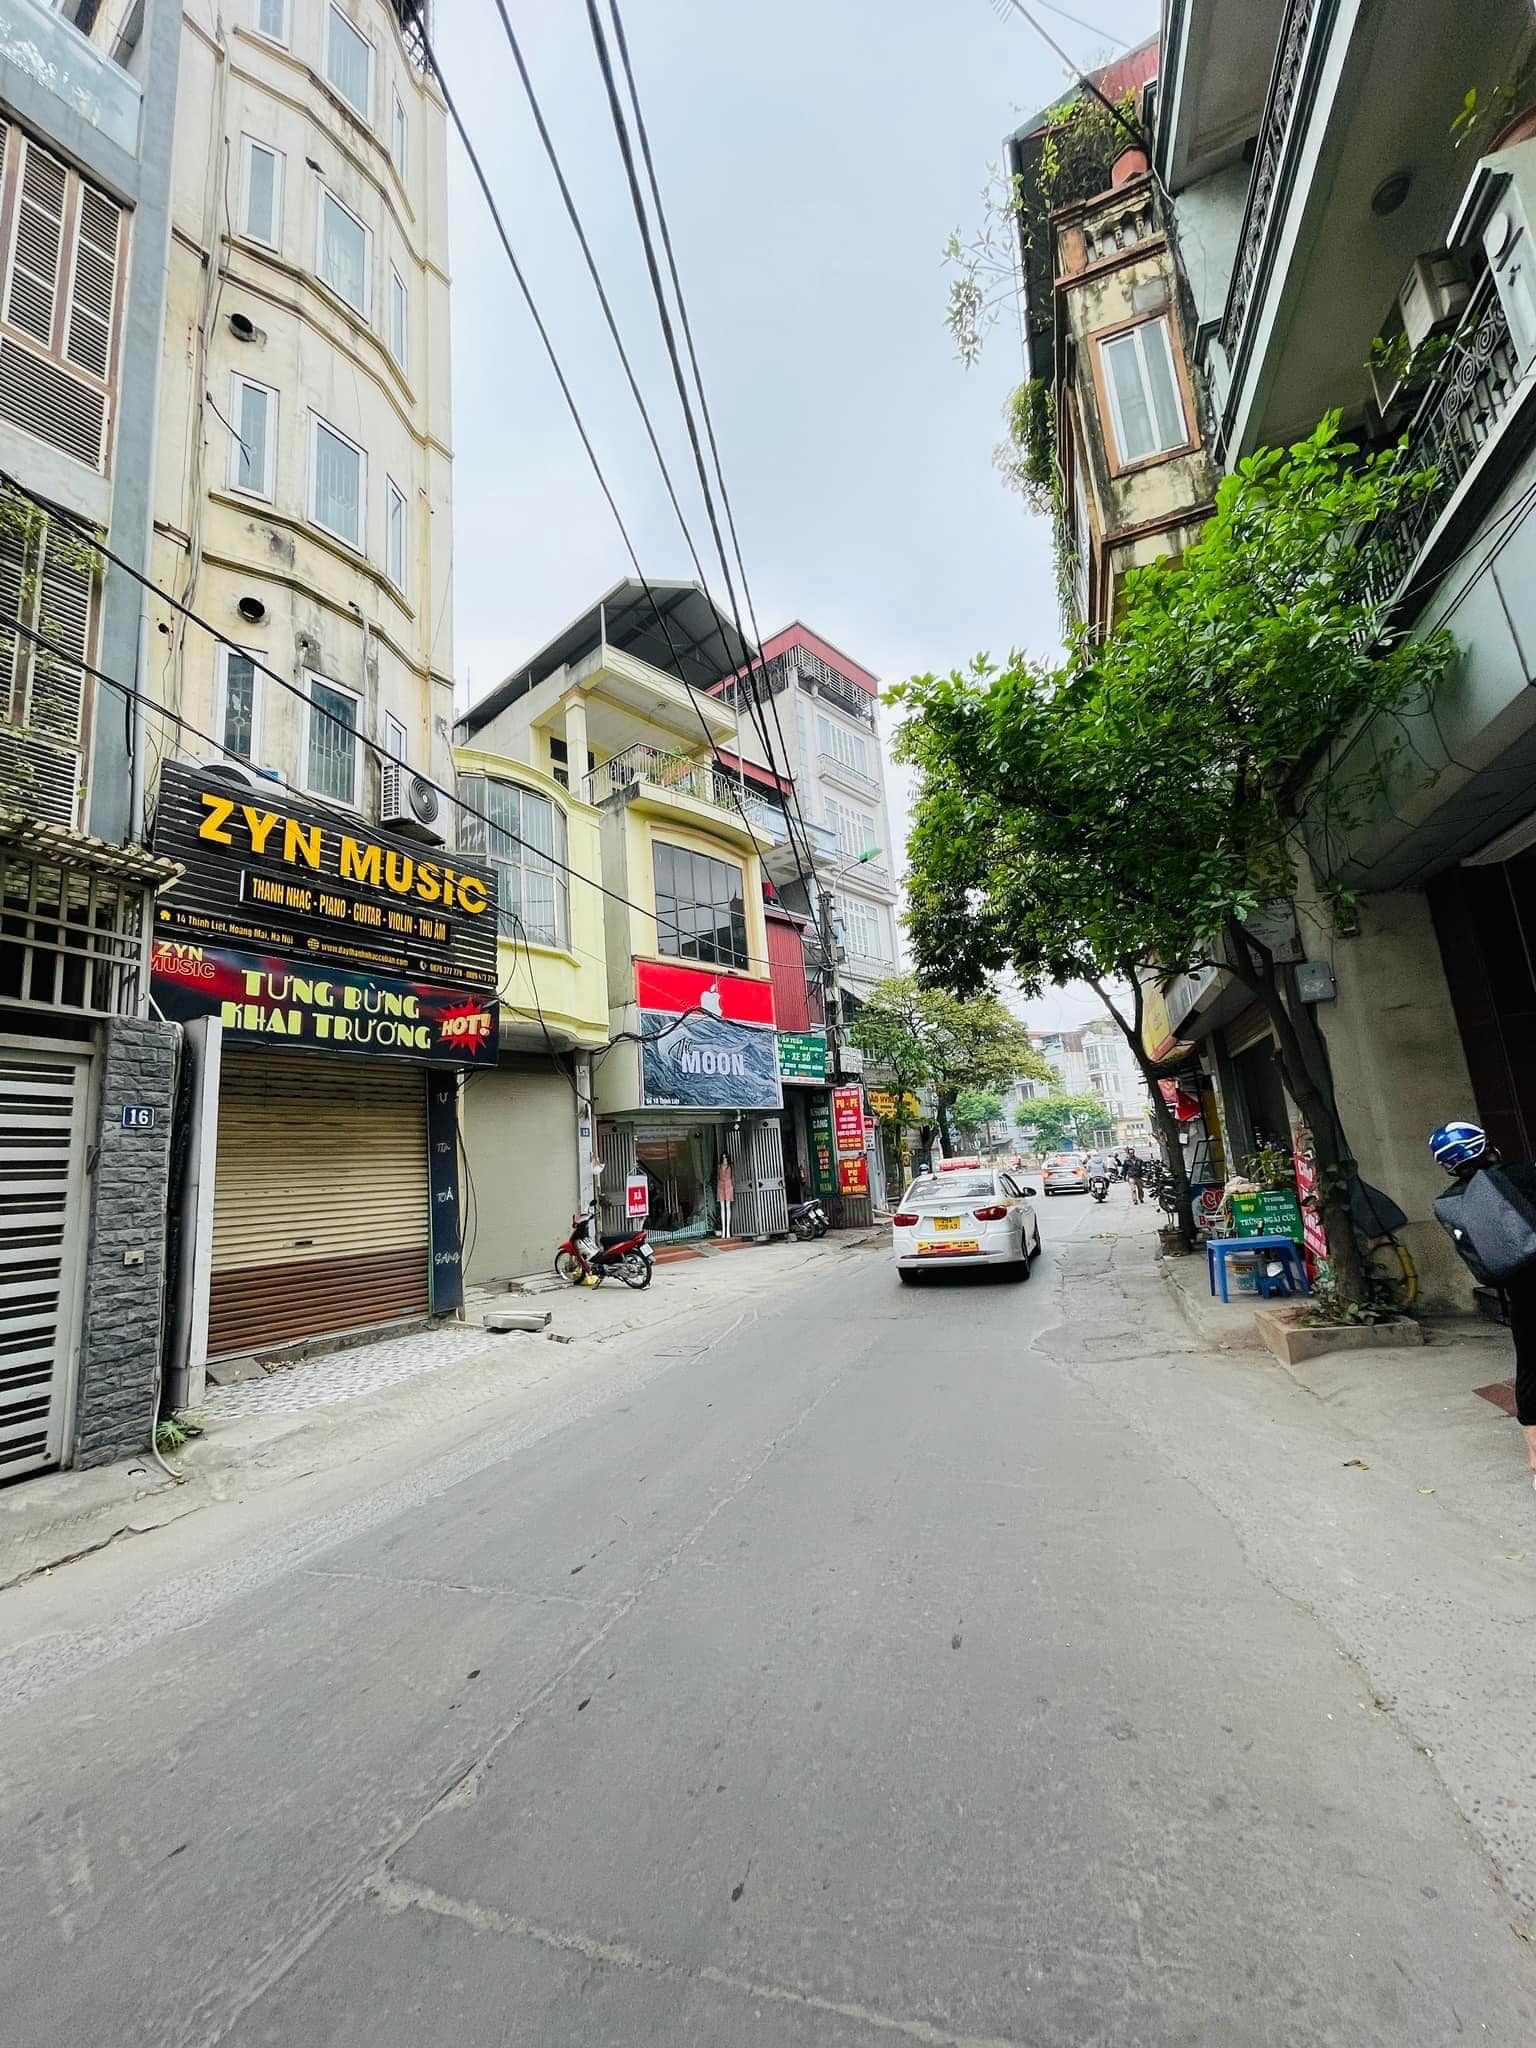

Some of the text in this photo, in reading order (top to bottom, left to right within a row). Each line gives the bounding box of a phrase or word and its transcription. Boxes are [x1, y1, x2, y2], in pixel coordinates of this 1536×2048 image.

[199, 792, 488, 915] ZYN MUSIC
[177, 913, 186, 924] 14
[252, 878, 284, 905] THANH
[286, 887, 312, 913] NHẠC
[320, 894, 346, 918] PIANO
[353, 902, 381, 926] GUITAR
[388, 911, 413, 934] VIOLIN
[419, 918, 433, 938] THU
[157, 940, 203, 961] ZYN
[152, 954, 216, 978] MUSIC
[344, 982, 420, 1019] BỪNG
[222, 1002, 431, 1049] KHAI TRƯƠNG
[441, 1012, 492, 1037] HOT!
[681, 1051, 745, 1076] MOON
[129, 1109, 149, 1125] 16
